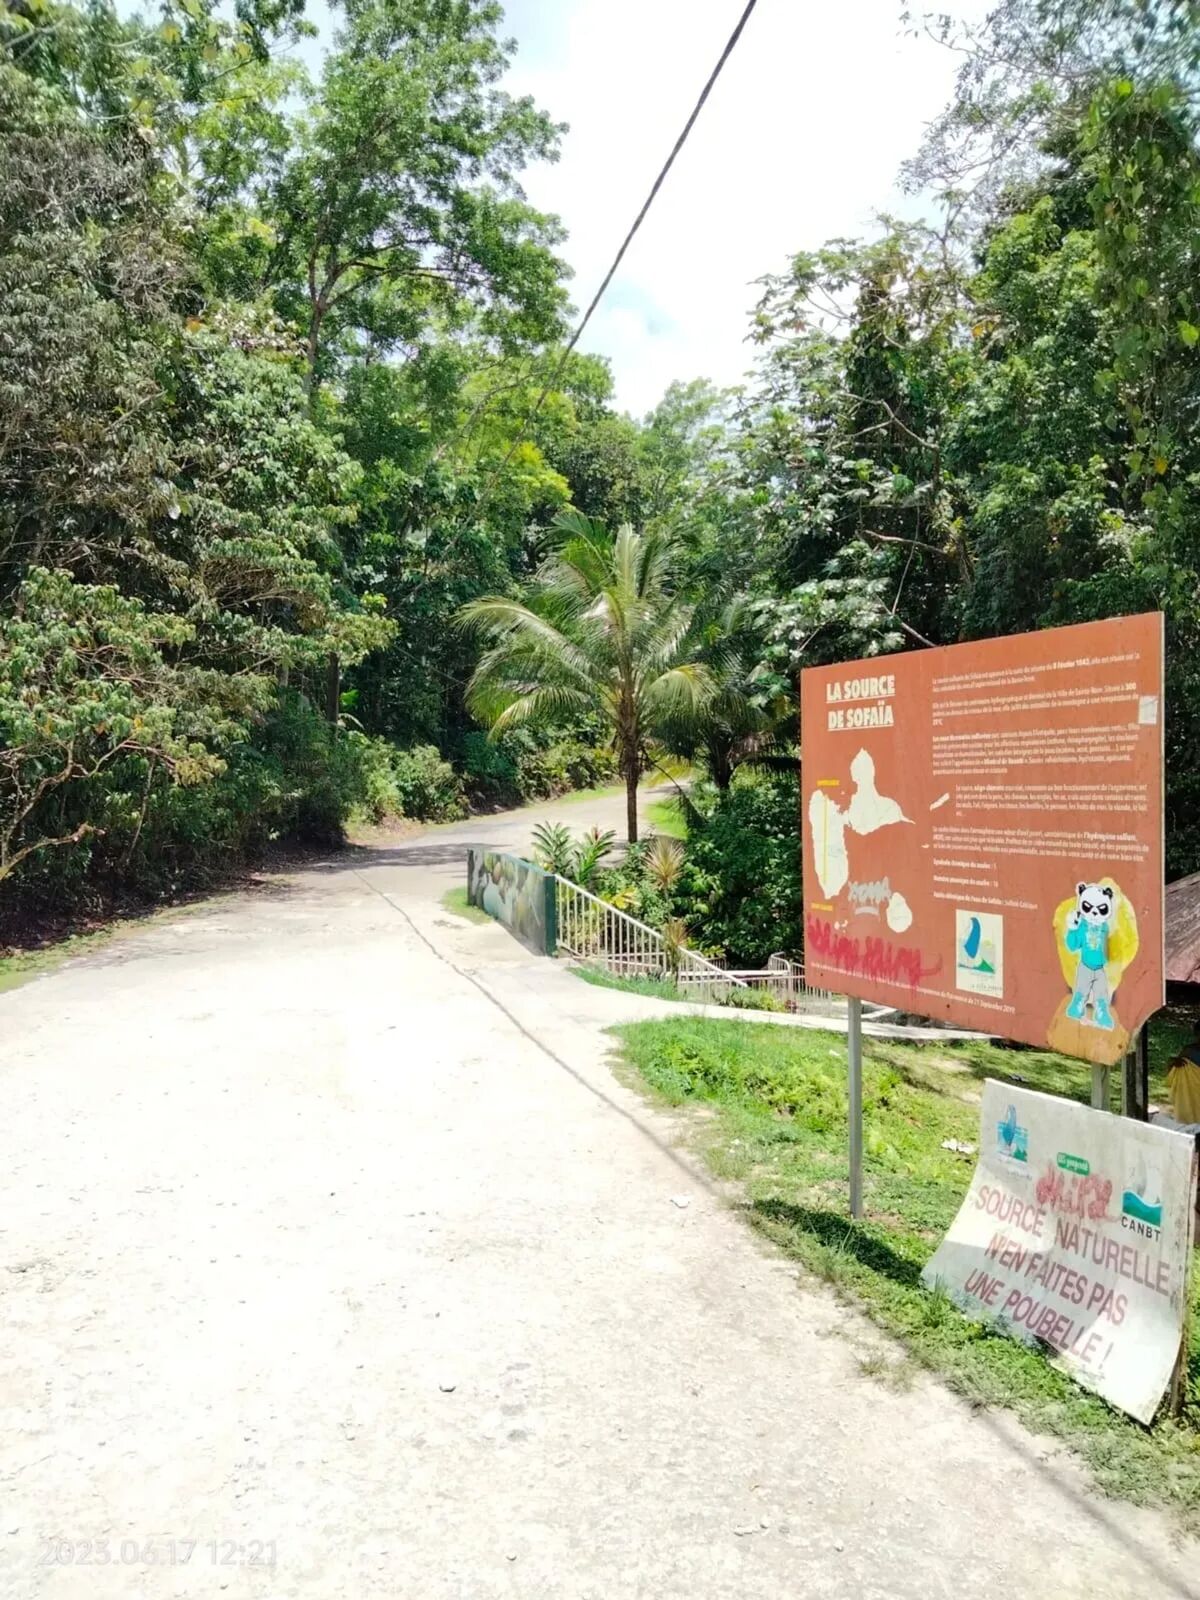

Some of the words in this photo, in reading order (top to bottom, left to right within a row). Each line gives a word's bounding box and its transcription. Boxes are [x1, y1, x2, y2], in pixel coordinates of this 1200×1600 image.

[826, 681, 842, 701] LA
[843, 674, 896, 699] SOURCE
[828, 709, 845, 729] DE
[846, 699, 895, 728] SOFAÏA
[974, 1184, 1047, 1238] SOURCE
[1121, 1215, 1162, 1244] CANBT
[984, 1232, 1029, 1274] N'EN
[1023, 1251, 1089, 1306] FAITES
[1086, 1280, 1129, 1327] PAS
[964, 1267, 1006, 1306] UNE
[1000, 1288, 1103, 1364] POUBELLE
